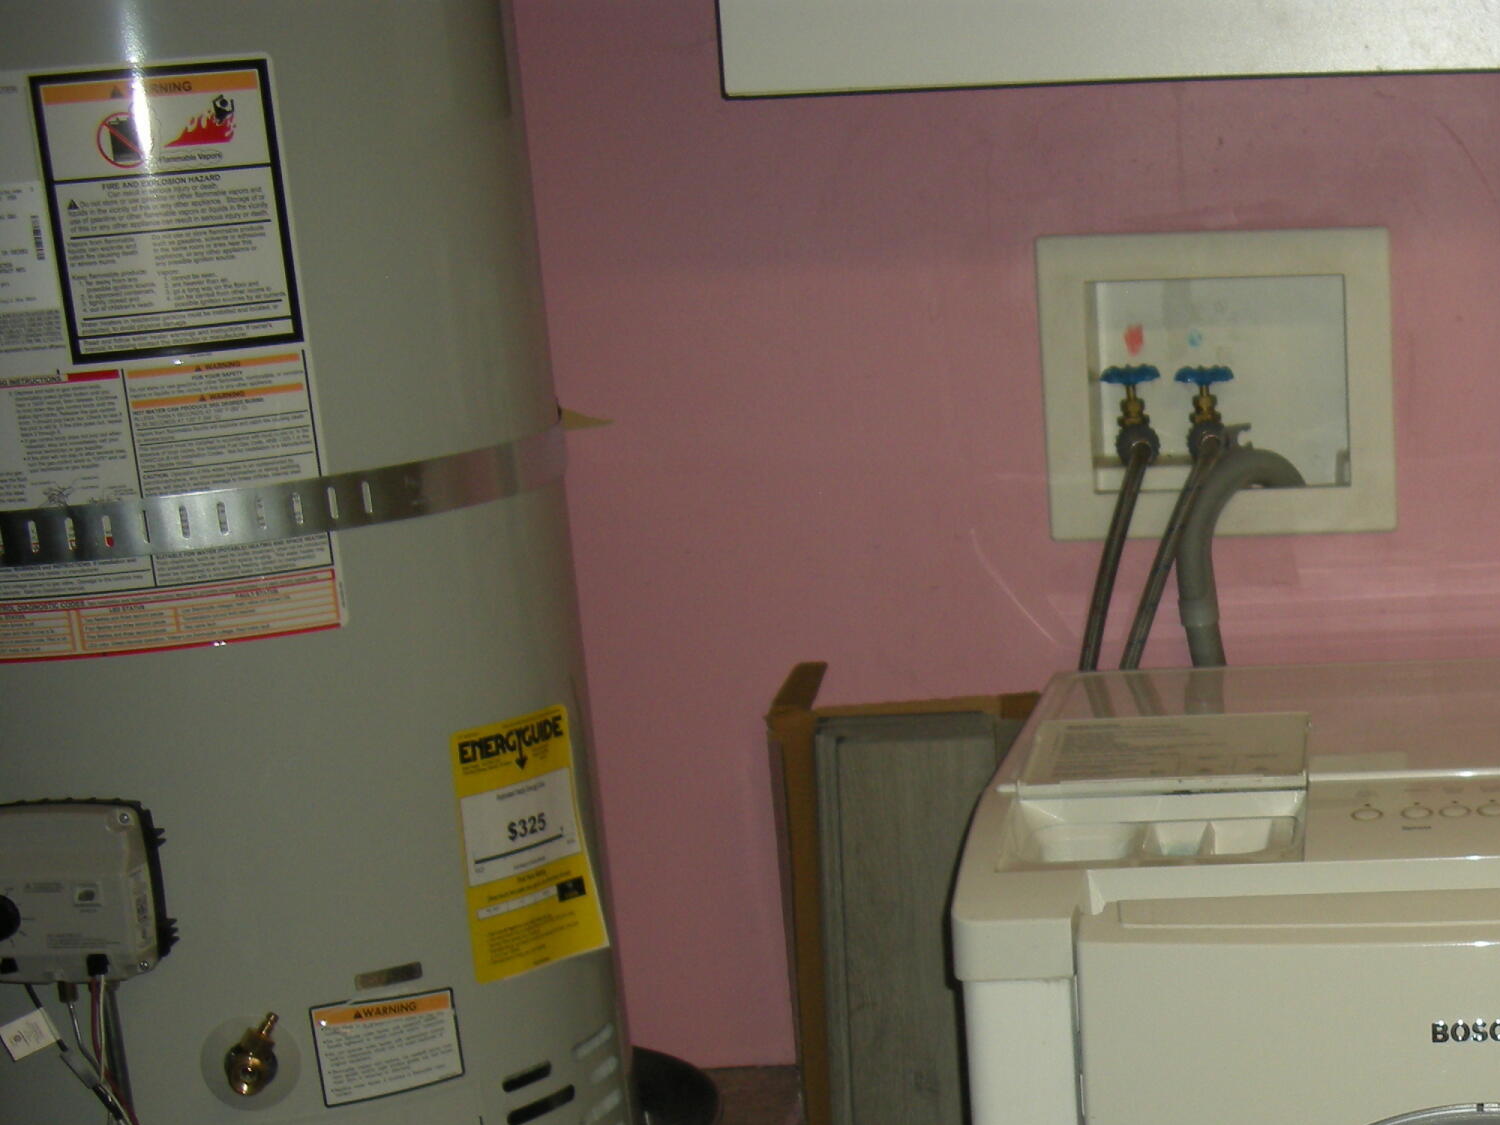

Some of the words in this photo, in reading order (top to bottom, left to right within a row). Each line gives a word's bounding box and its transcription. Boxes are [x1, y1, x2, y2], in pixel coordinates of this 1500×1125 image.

[458, 714, 563, 765] ENERGYGUIDE
[507, 812, 547, 842] $325
[362, 1001, 417, 1017] WARNING
